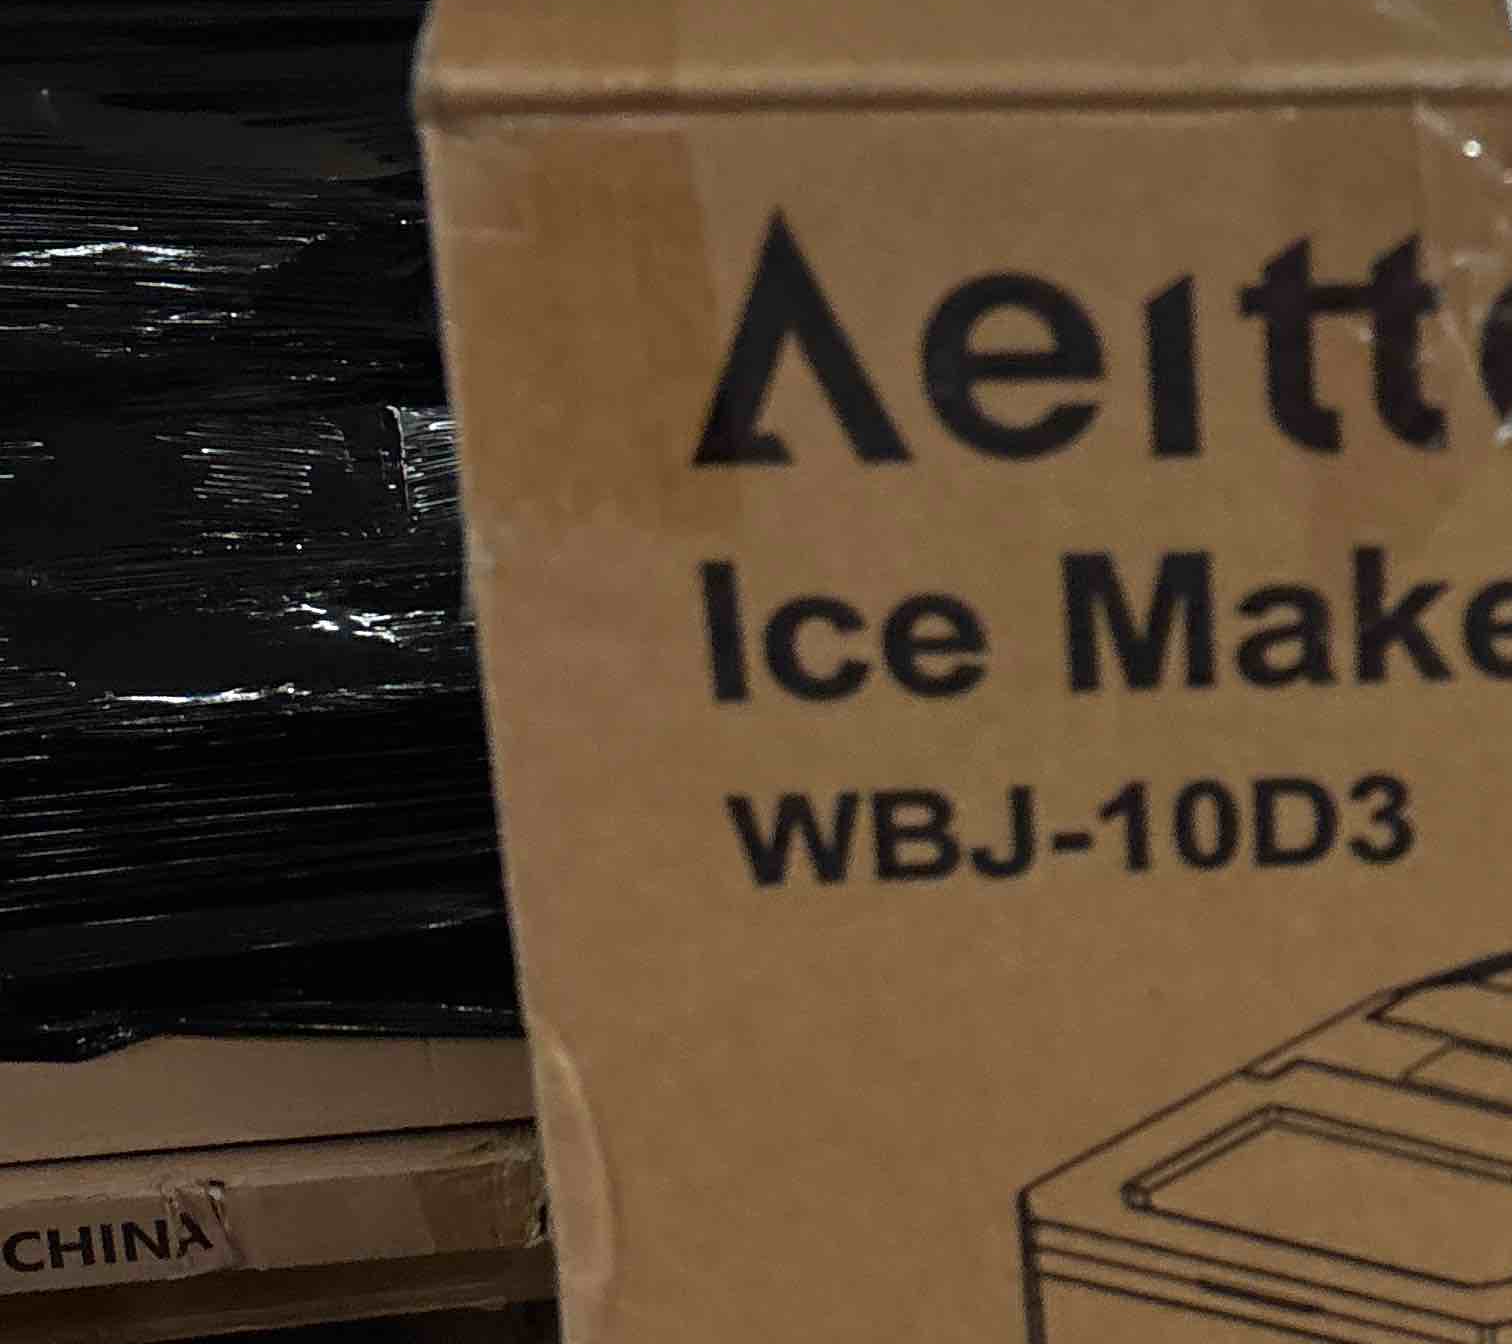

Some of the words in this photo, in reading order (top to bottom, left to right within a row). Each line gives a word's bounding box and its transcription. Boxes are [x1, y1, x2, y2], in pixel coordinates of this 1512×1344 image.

[698, 557, 989, 704] Ice
[725, 770, 1416, 887] WBJ-10D3
[2, 1212, 214, 1273] CHINA
